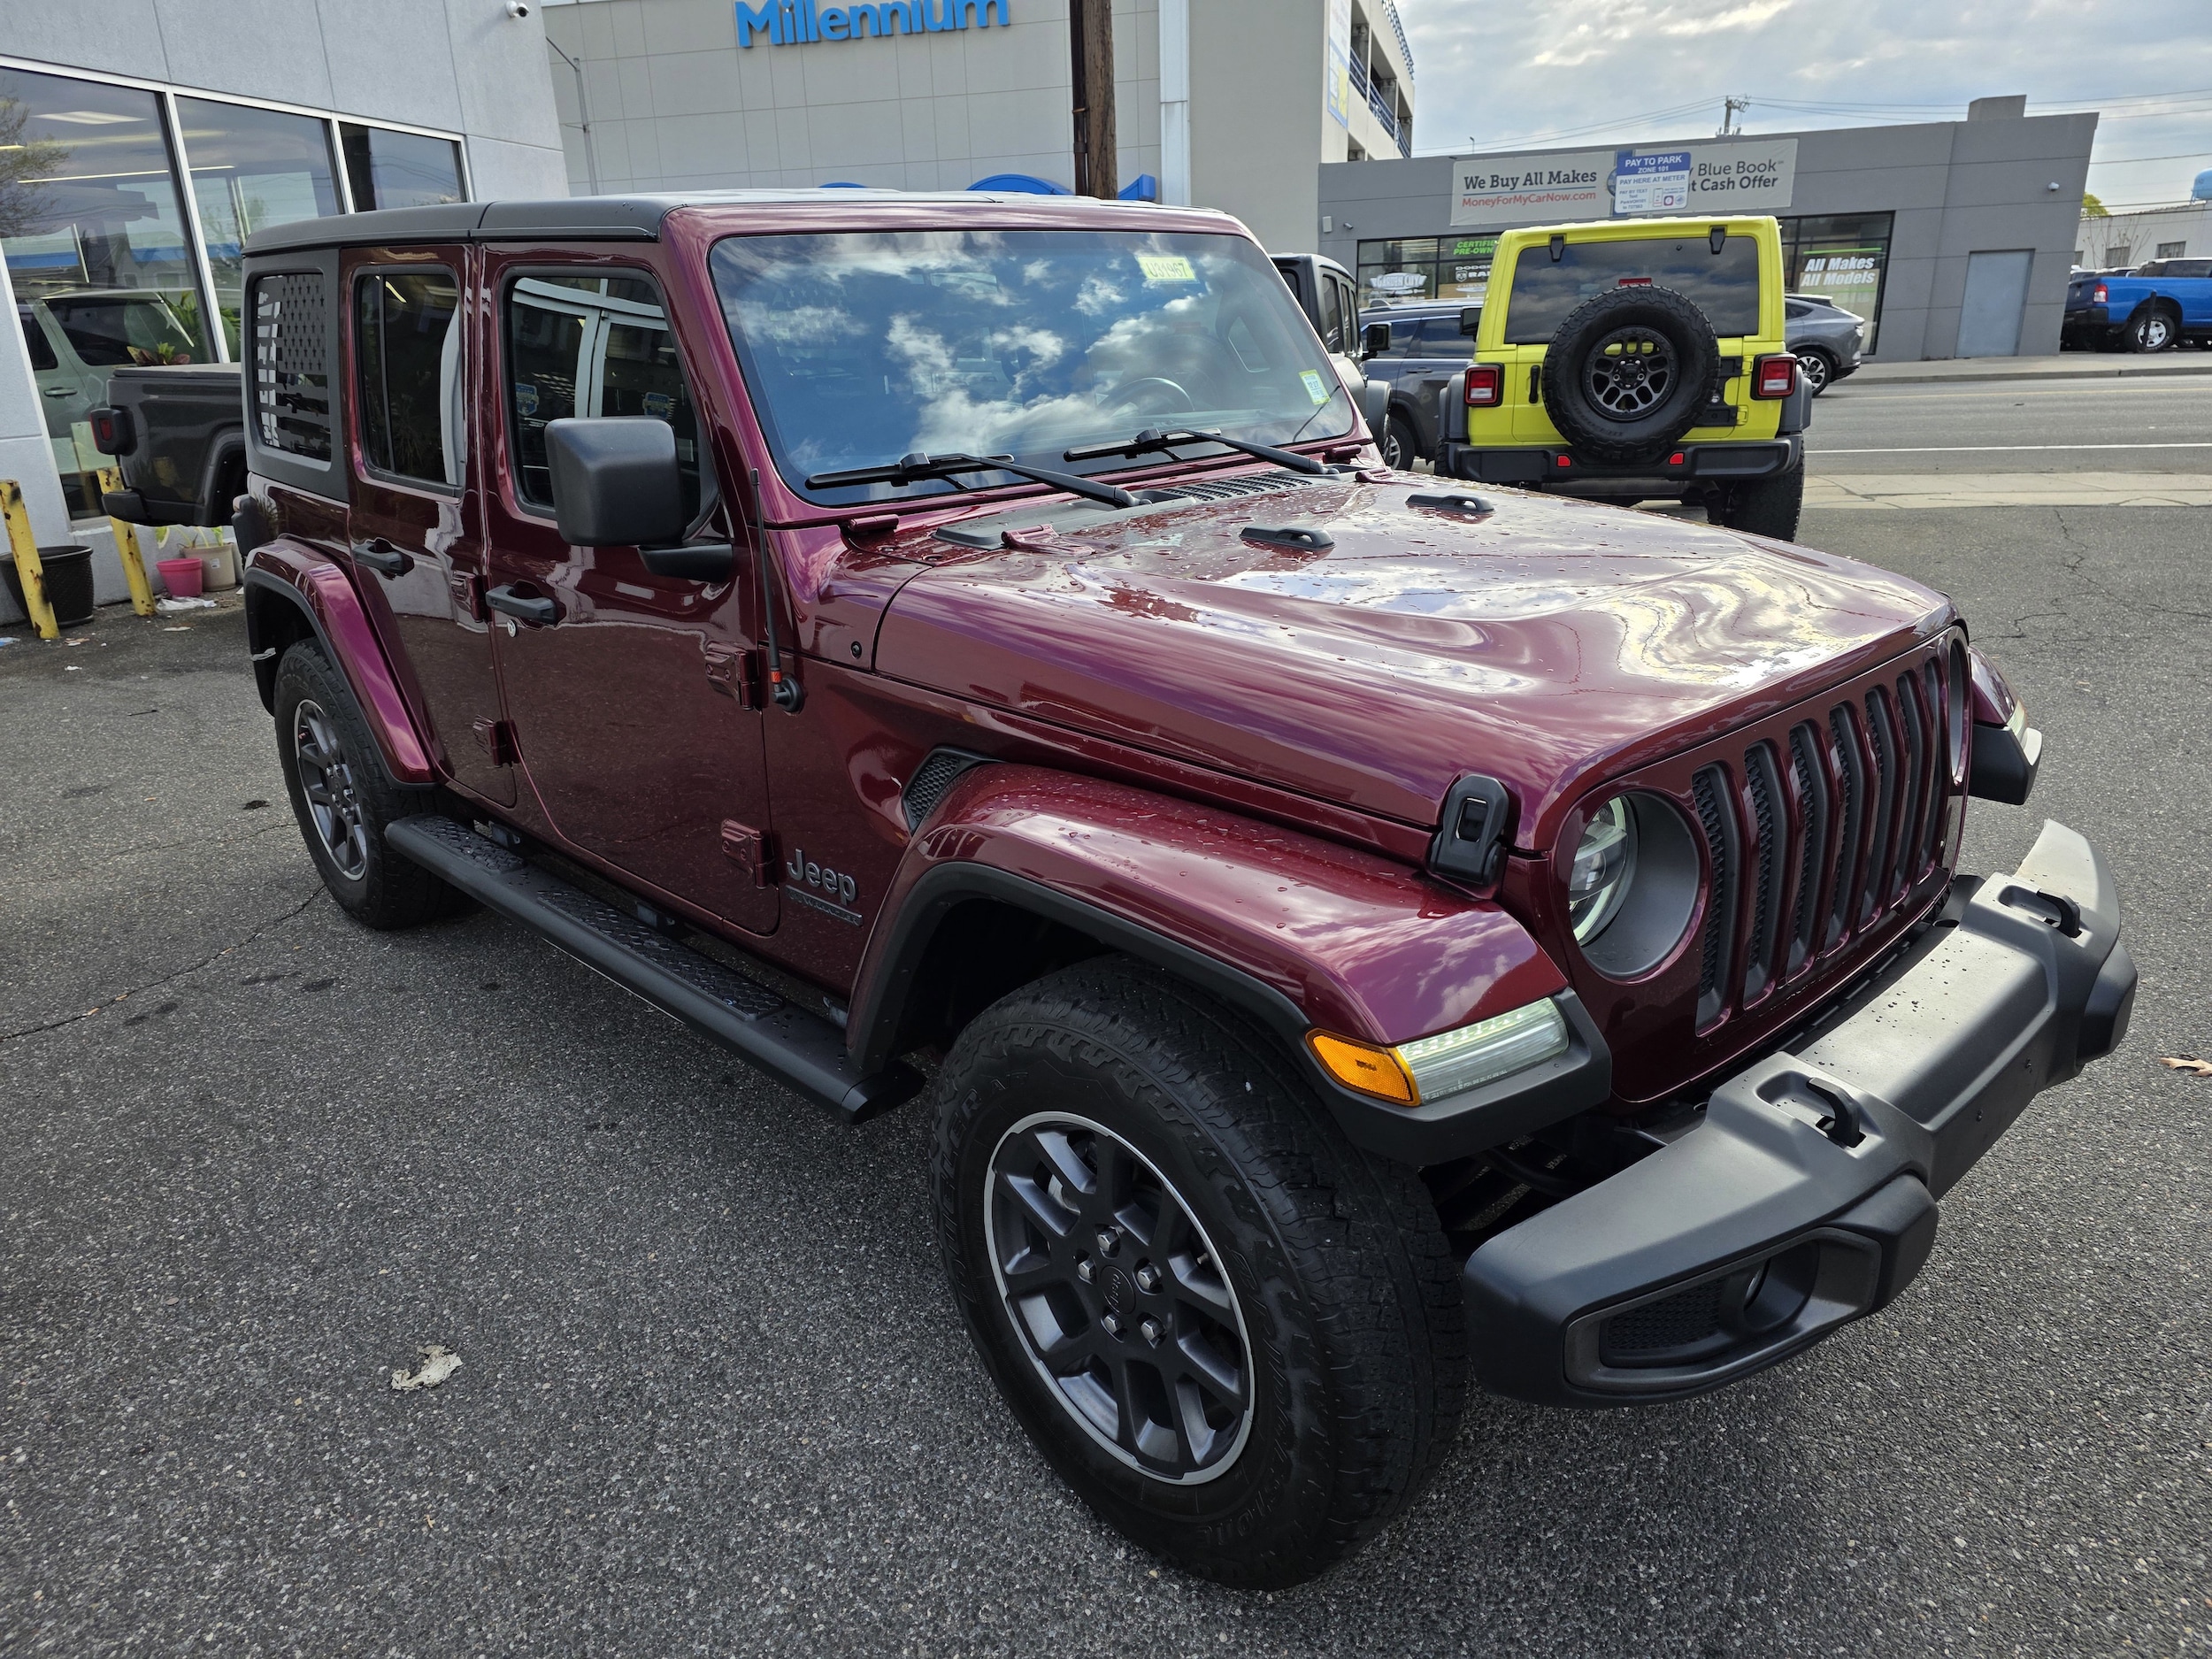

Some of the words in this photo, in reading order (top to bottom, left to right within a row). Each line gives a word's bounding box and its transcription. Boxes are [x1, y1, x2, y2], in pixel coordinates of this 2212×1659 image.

[734, 0, 1010, 48] Millennium
[1624, 158, 1642, 167] PAY
[1643, 157, 1655, 165] TO
[1657, 155, 1682, 164] PARK
[1698, 163, 1732, 176] Blue
[1737, 158, 1777, 174] Book
[1463, 176, 1486, 189] We
[1490, 174, 1519, 190] Buy
[1523, 172, 1544, 186] All
[1548, 170, 1597, 184] Makes
[1701, 177, 1735, 191] Cash
[1740, 175, 1778, 189] Offer
[1462, 191, 1596, 208] MoneyForMyCarNow.com
[1804, 258, 1826, 272] All
[1827, 257, 1875, 270] Makes
[1801, 273, 1821, 287] All
[1823, 271, 1875, 285] Models
[787, 849, 856, 906] Jeep
